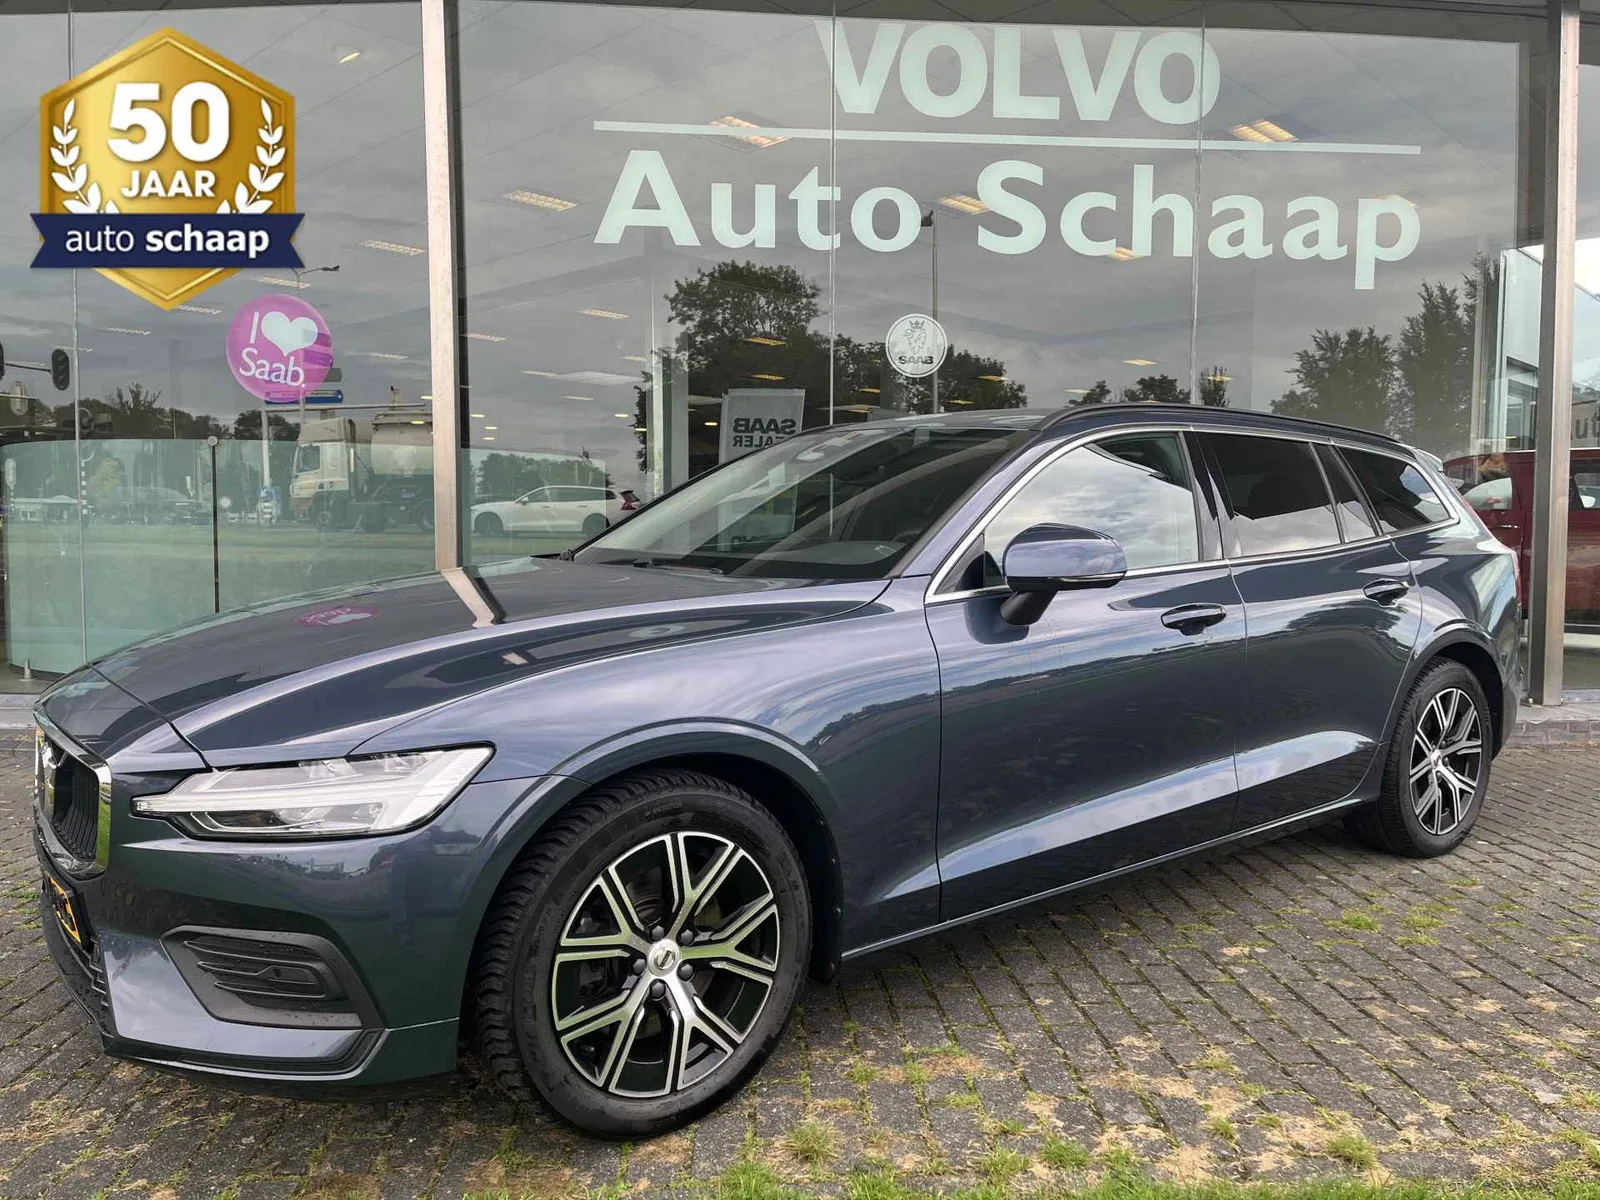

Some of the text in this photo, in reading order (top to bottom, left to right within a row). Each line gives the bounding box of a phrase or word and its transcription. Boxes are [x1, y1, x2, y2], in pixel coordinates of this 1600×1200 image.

[813, 20, 1221, 125] VOLVO
[593, 149, 1421, 290] Auto Schaap
